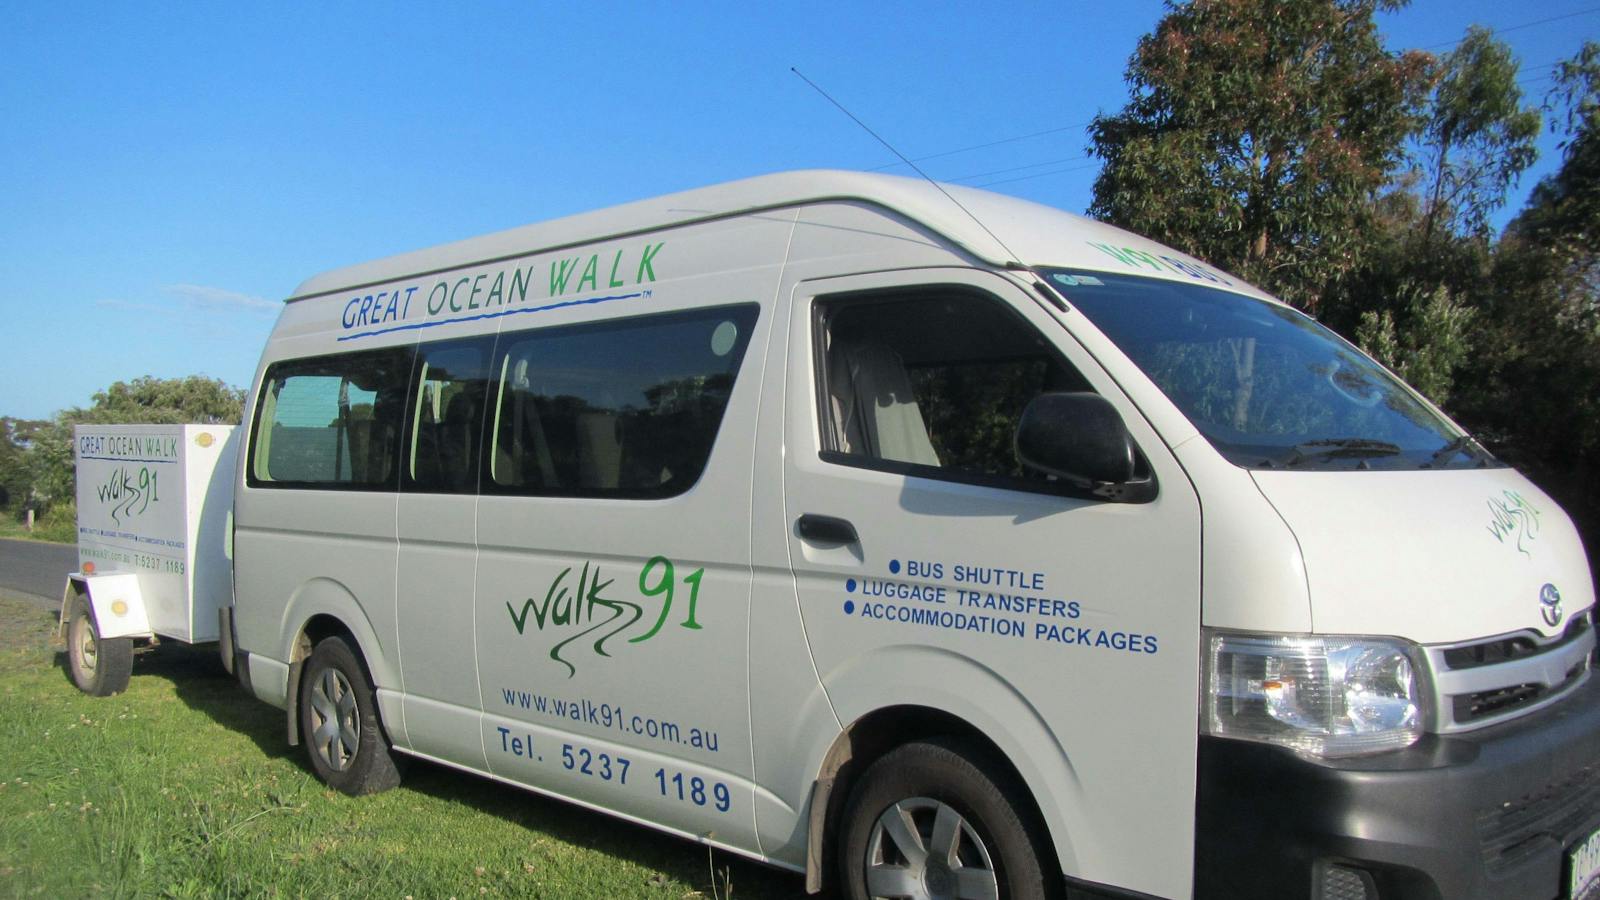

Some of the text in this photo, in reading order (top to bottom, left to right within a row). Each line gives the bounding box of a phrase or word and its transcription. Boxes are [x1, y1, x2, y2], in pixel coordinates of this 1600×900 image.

[342, 286, 419, 330] GREAT
[427, 266, 534, 316] OCEAN
[550, 242, 665, 297] WALK
[80, 436, 177, 457] GREAT OCEAN WALK
[166, 561, 185, 575] 1189
[907, 560, 1045, 590] BUS SHUTTLE
[862, 579, 1081, 619] LUGGAGE TRANSFERS
[861, 602, 1158, 654] ACCOMMODATION PACKAGES
[502, 688, 719, 752] www.walk91.com.au
[497, 727, 731, 812] Tel. 5237 1189
